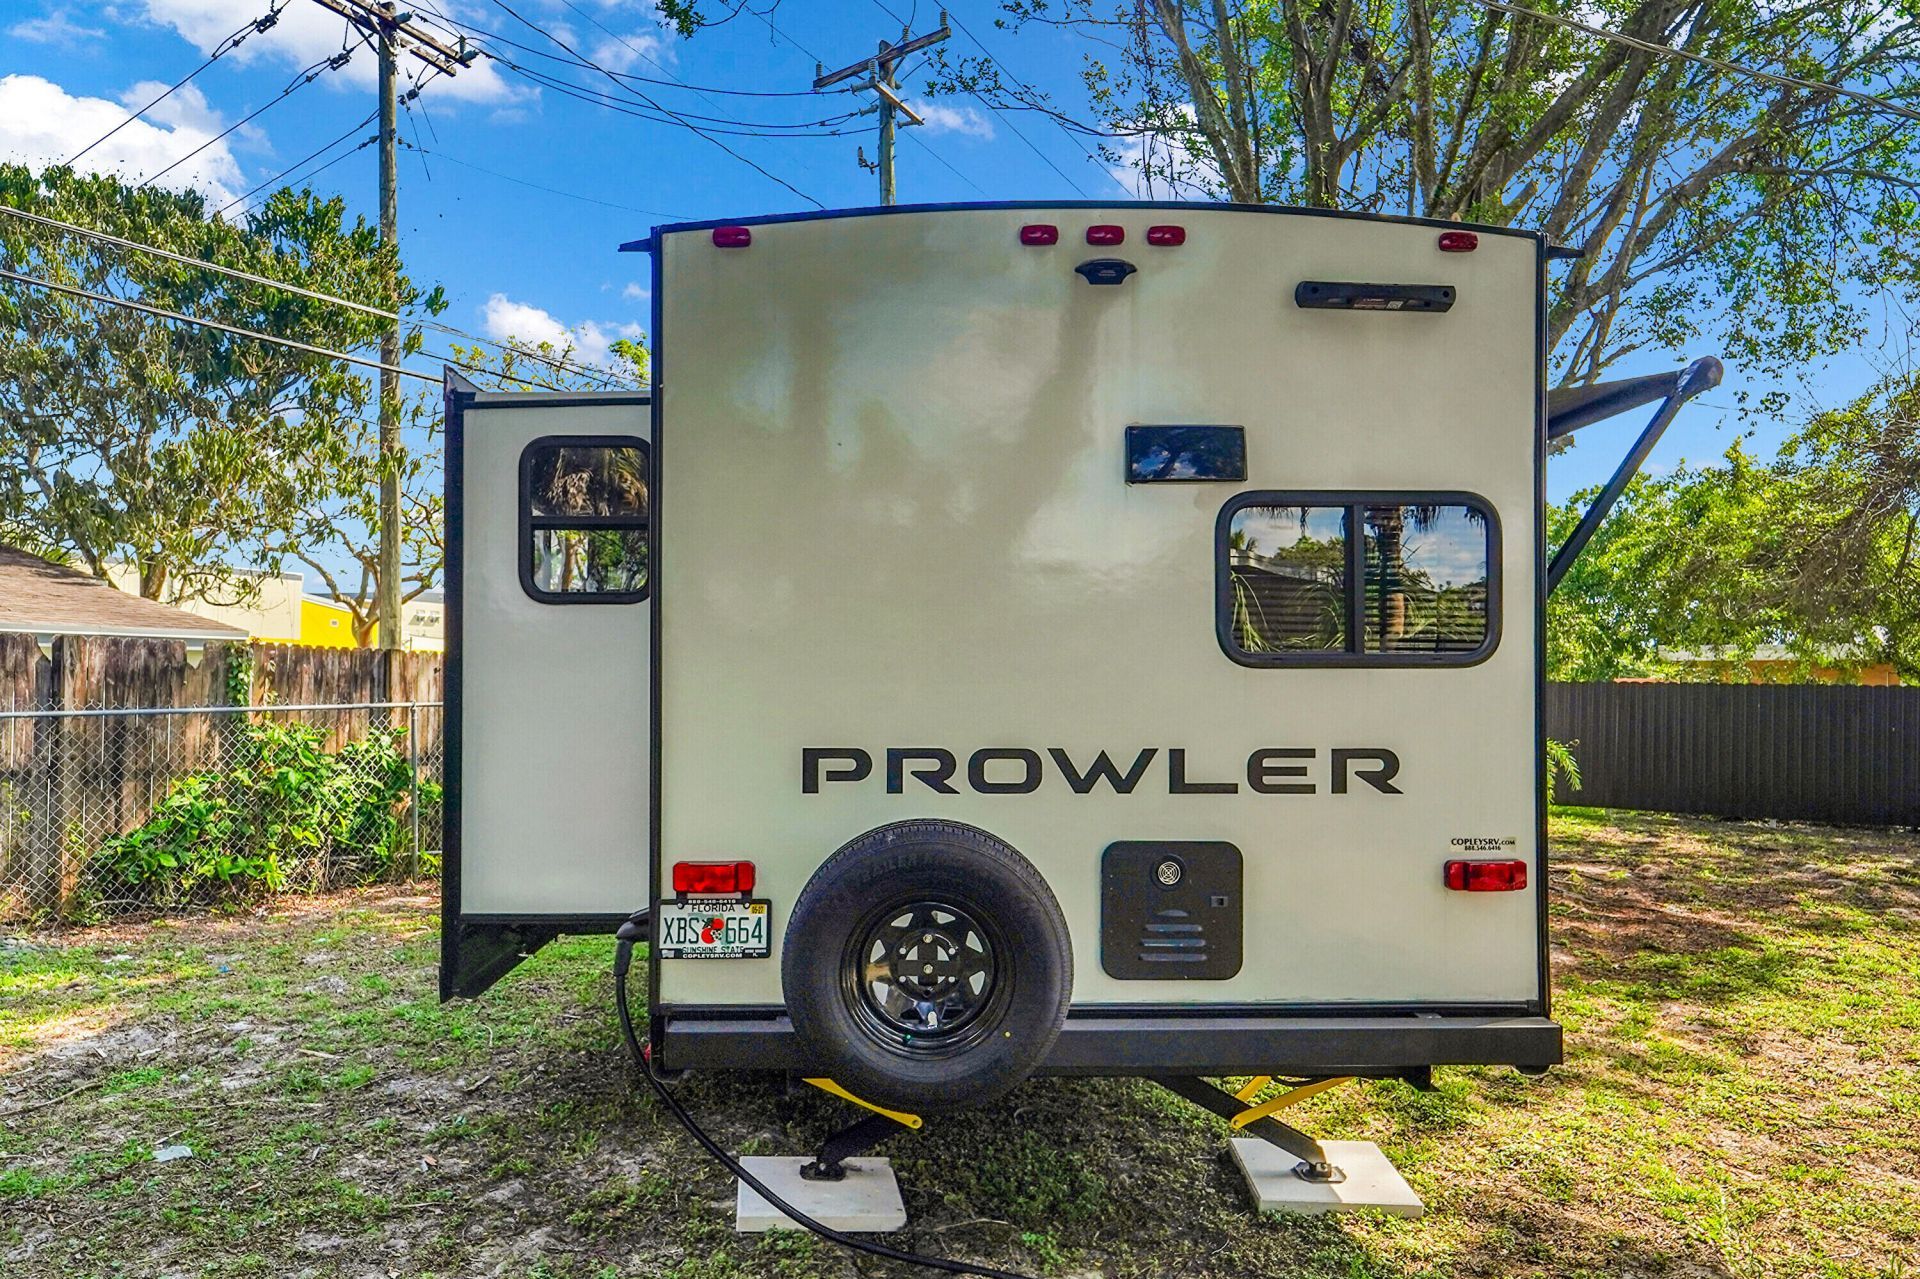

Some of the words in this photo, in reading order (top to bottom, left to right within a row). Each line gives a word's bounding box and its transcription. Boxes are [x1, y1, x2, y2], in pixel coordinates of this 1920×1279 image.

[801, 747, 1405, 795] PROWLER
[691, 904, 736, 912] FLORIDA
[663, 916, 700, 944] XBS
[725, 916, 763, 944] 664
